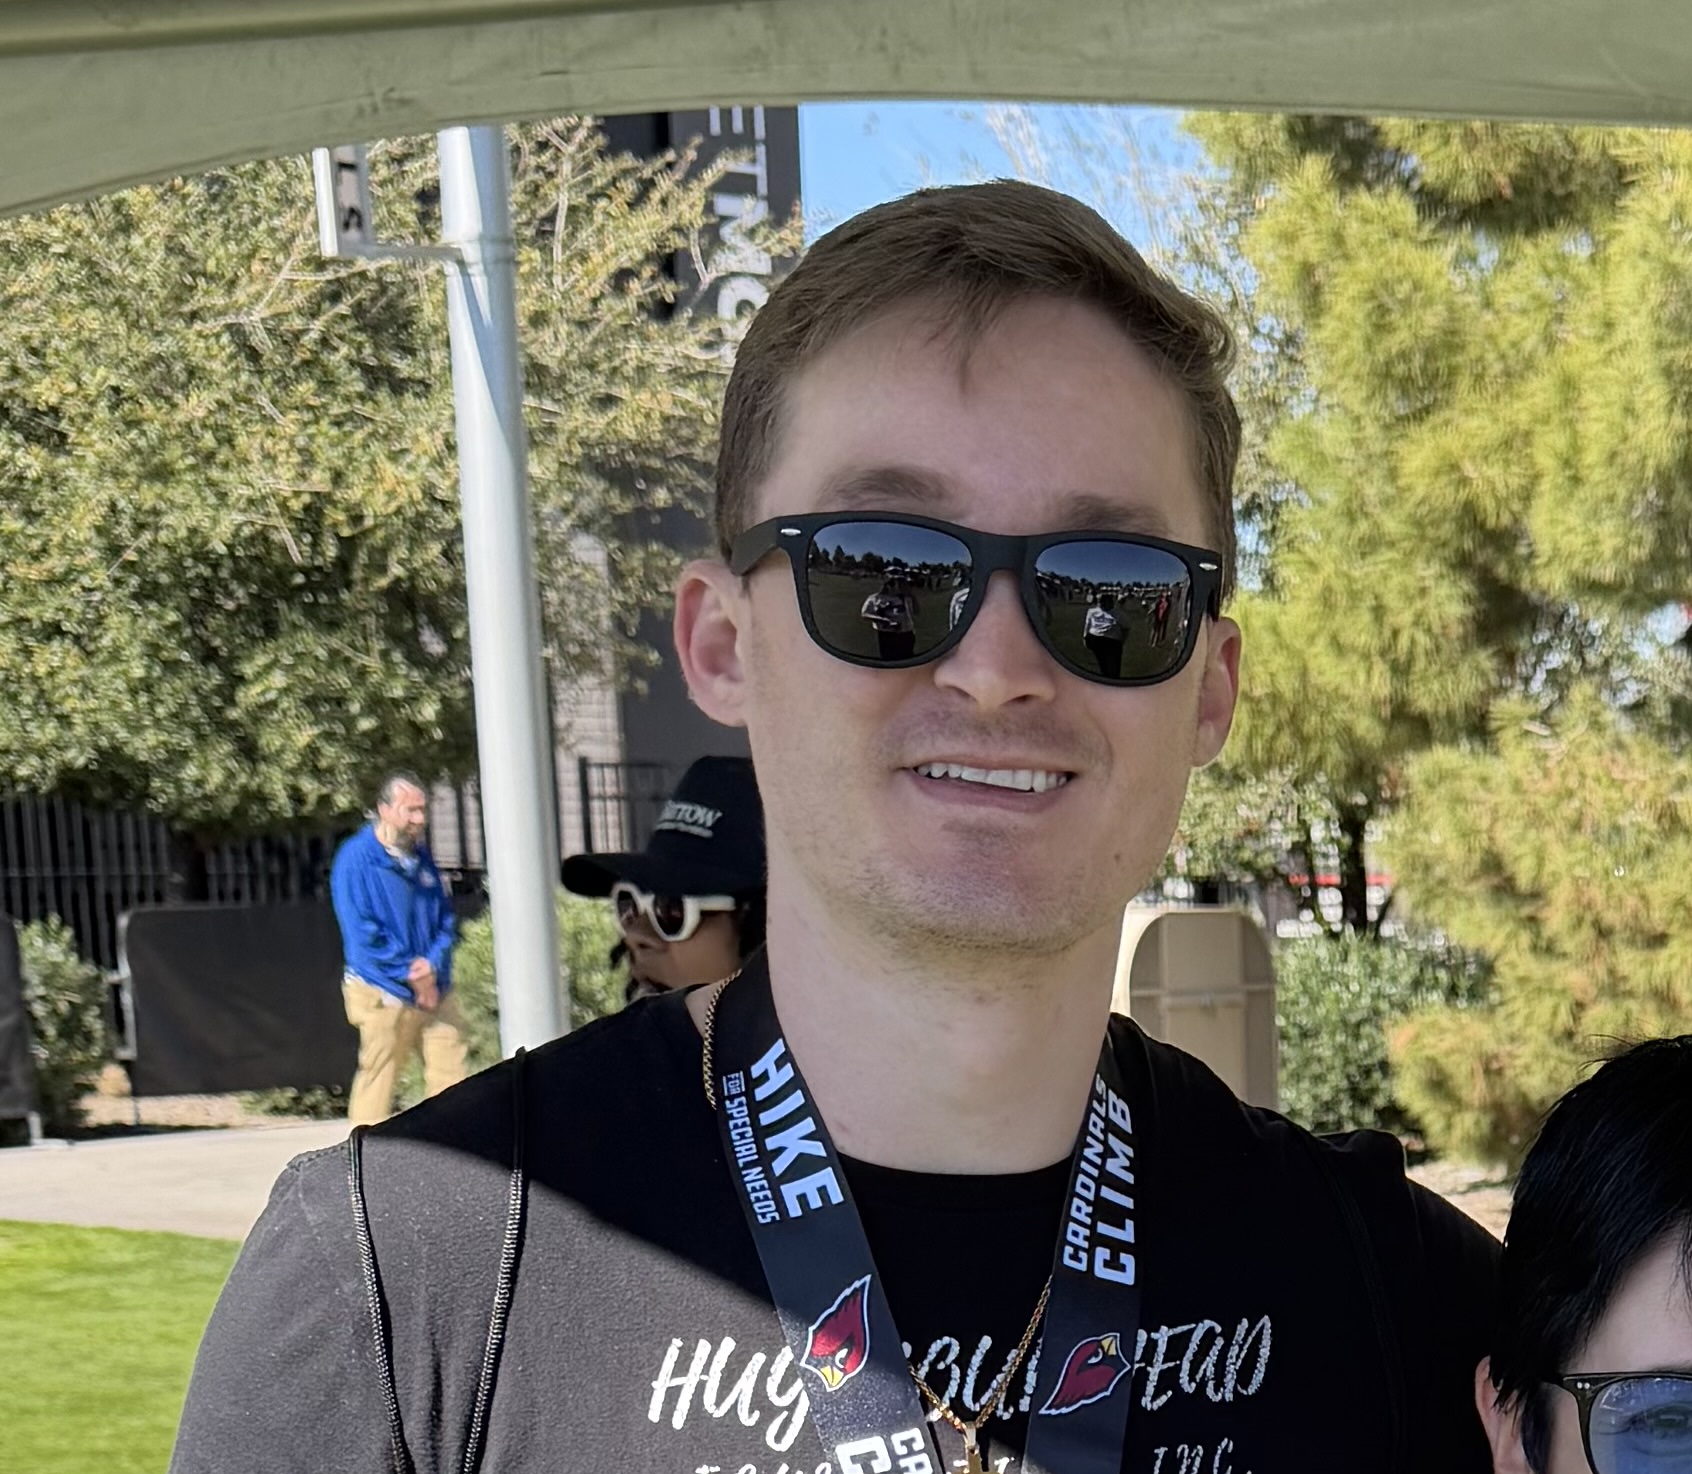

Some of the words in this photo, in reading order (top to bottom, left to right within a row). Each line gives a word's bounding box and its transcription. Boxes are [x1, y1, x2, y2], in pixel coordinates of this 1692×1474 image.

[725, 1096, 758, 1168] SPECIAL
[742, 1166, 780, 1224] NEEDS
[750, 1038, 844, 1218] HIKE
[1062, 1073, 1107, 1272] CARDINALS
[1093, 1088, 1135, 1286] CLIMB
